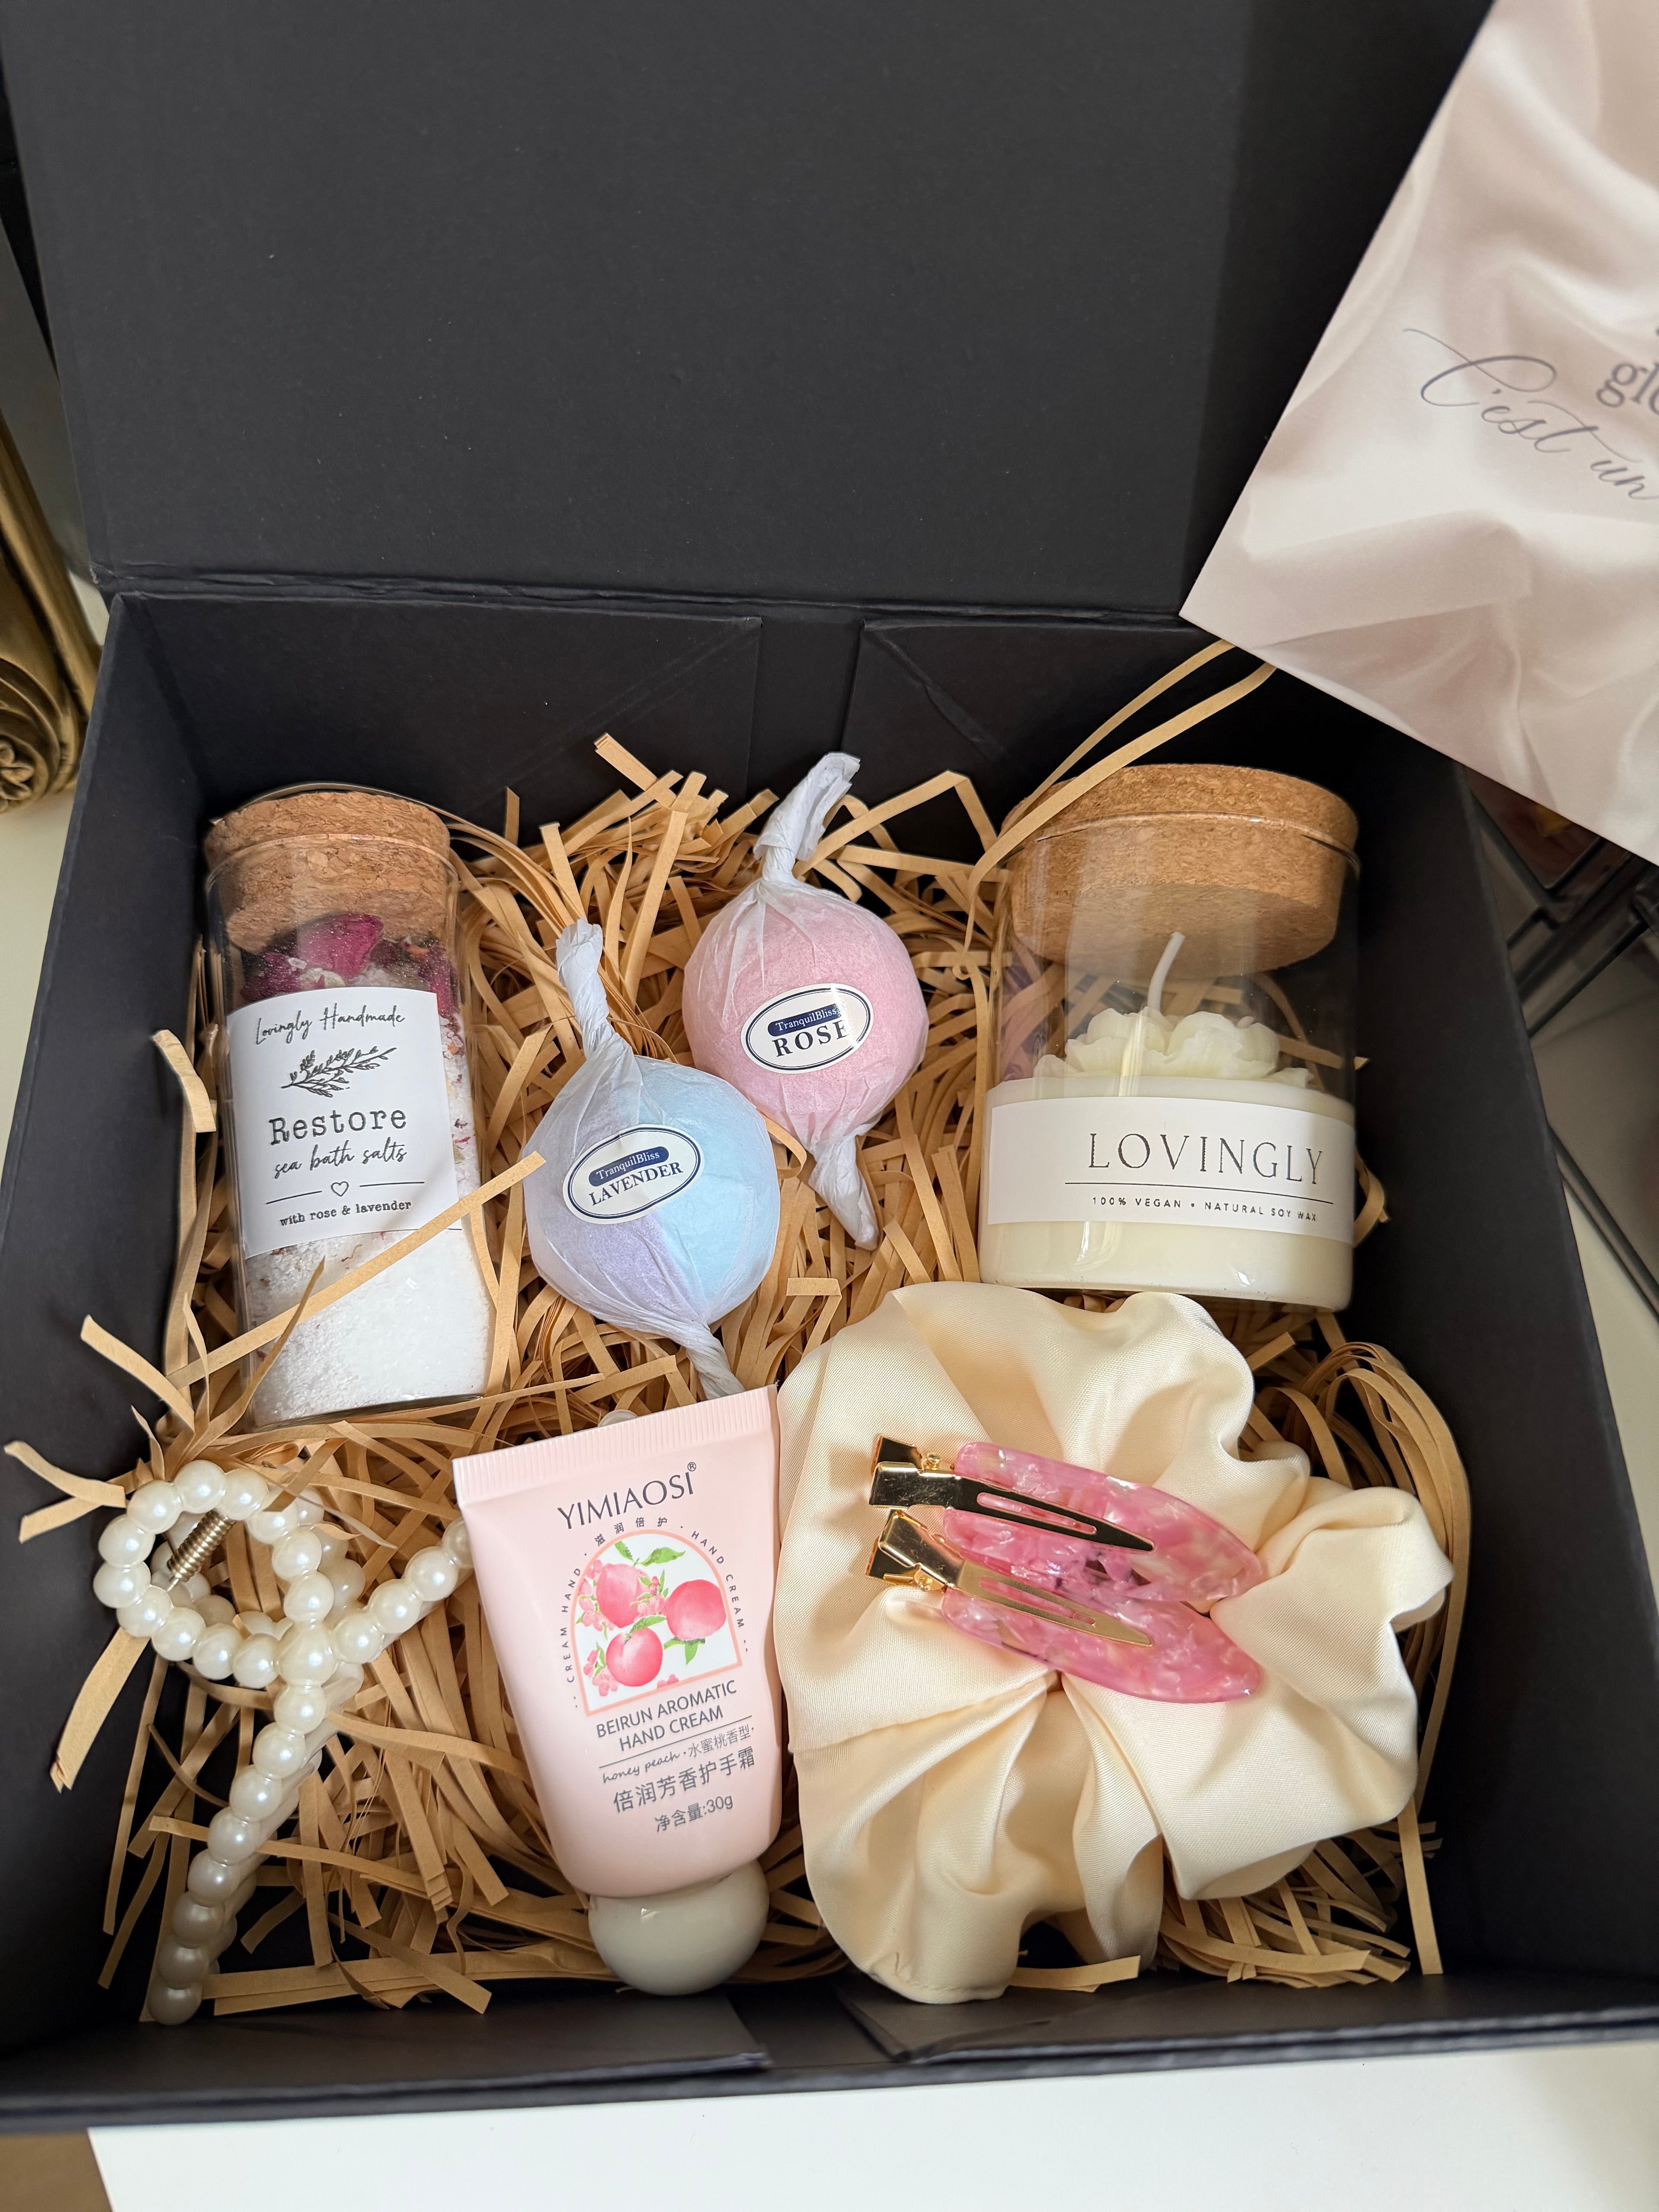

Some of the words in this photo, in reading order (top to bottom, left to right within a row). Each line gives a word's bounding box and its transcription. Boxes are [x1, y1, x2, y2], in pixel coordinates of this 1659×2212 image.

[256, 1010, 313, 1045] Lovingly
[320, 1003, 405, 1031] Handmade
[772, 1020, 850, 1057] ROSE
[775, 1007, 837, 1031] TranquilBliss
[269, 1109, 407, 1146] Restore
[274, 1162, 302, 1179] sea
[310, 1140, 355, 1171] bath
[362, 1137, 407, 1164] salts
[596, 1150, 660, 1180] TranquilBliss
[1089, 1133, 1322, 1185] LOVINGLY
[589, 1162, 684, 1206] LAVENDER
[280, 1212, 305, 1226] with
[310, 1208, 337, 1220] rose
[342, 1206, 350, 1215] &
[356, 1200, 411, 1214] lavender
[1092, 1197, 1127, 1206] 100%
[1135, 1198, 1181, 1208] VEGAN
[1205, 1202, 1263, 1215] NATURAL
[1271, 1208, 1291, 1217] SOY
[1297, 1211, 1316, 1222] WAX
[562, 1567, 581, 1613] HAND
[691, 1531, 724, 1564] HAND
[725, 1574, 745, 1628] CREAM
[560, 1627, 575, 1683] CREAM
[596, 1707, 653, 1738] BEIRUN
[658, 1680, 737, 1718] AROMATIC
[619, 1725, 665, 1751] HAND
[669, 1705, 724, 1734] CREAM
[603, 1765, 640, 1784] honey
[645, 1751, 680, 1773] peach
[613, 1746, 755, 1813] 倍润芳香护手霜
